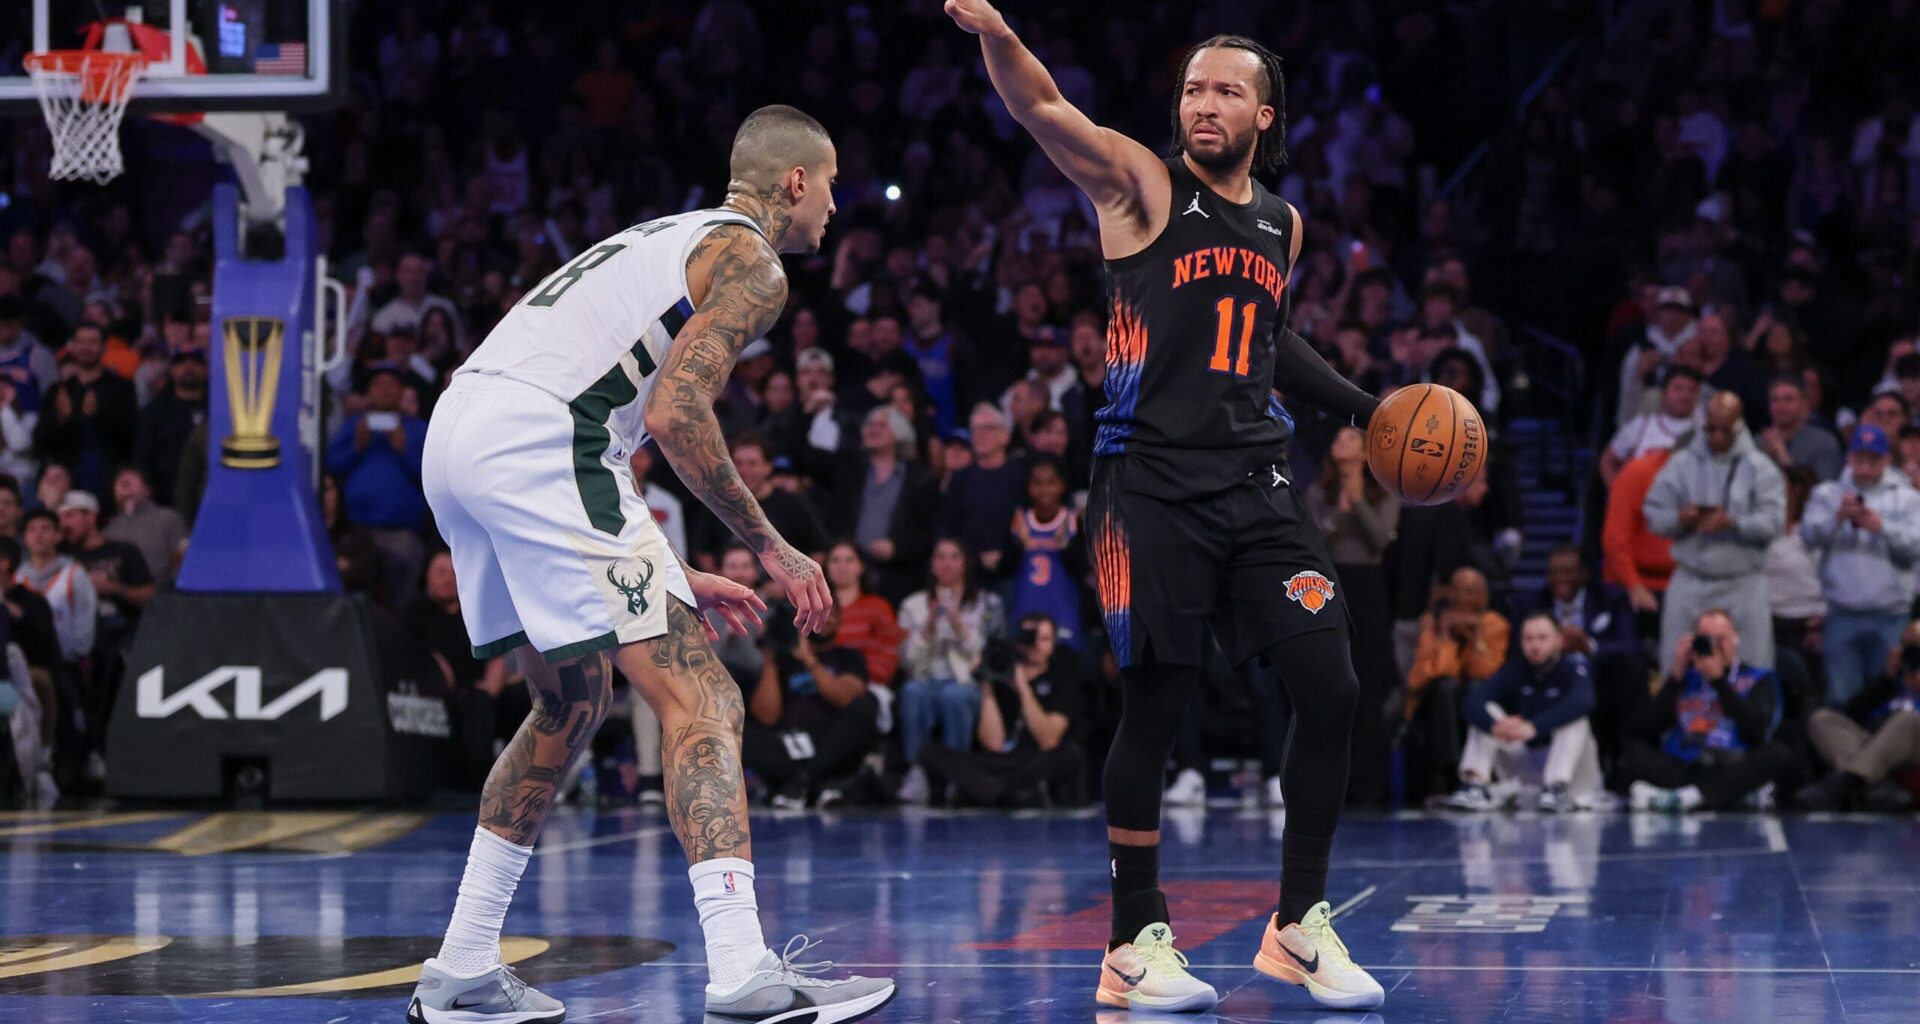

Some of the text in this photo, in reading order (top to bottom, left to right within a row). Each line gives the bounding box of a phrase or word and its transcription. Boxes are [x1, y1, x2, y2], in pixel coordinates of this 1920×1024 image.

[517, 243, 628, 307] 8
[1173, 247, 1284, 311] NEW YORK
[1208, 296, 1258, 377] 11
[1029, 554, 1051, 587] 3
[1288, 575, 1333, 598] KNICKS
[136, 664, 349, 722] KIA
